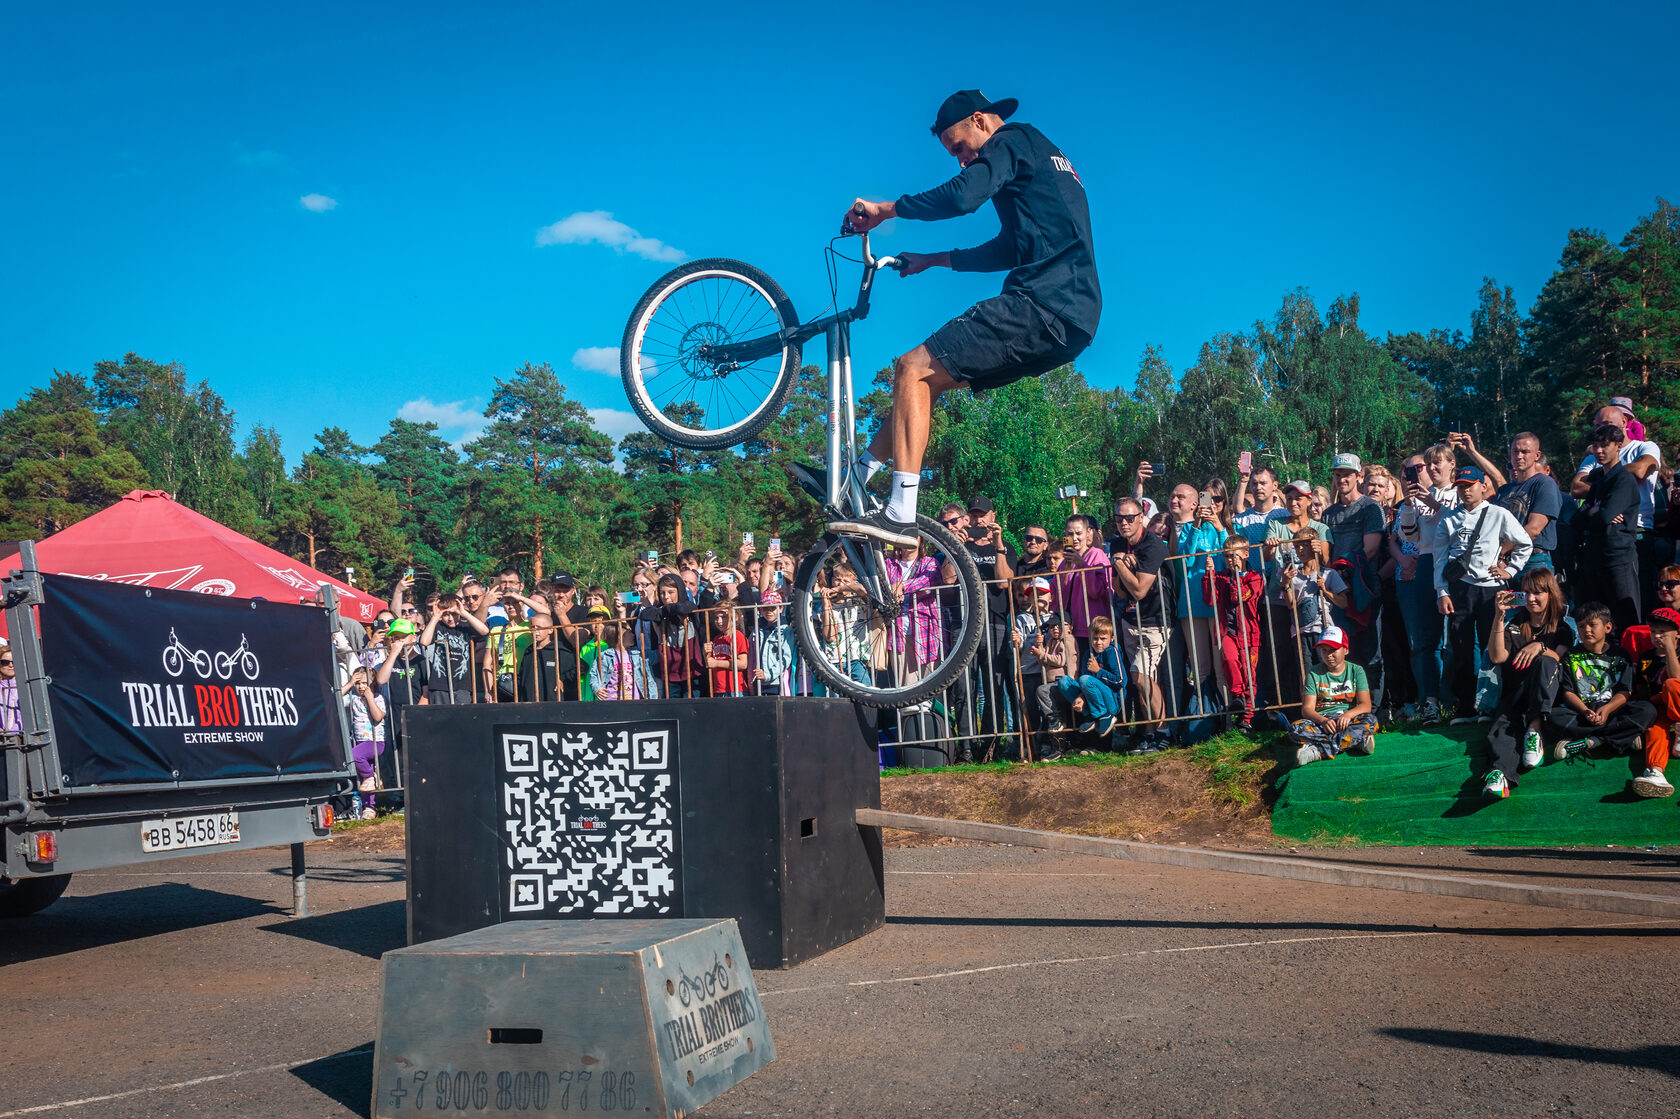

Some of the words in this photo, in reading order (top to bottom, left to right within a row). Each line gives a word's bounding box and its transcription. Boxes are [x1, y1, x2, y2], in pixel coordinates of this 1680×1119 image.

[634, 392, 656, 421] KENDA
[121, 681, 196, 727] TRIAL
[193, 684, 299, 727] BROTHERS
[183, 732, 234, 744] EXTREME
[235, 731, 264, 743] SHOW
[175, 818, 216, 844] 5458
[219, 815, 233, 833] 66
[219, 833, 230, 841] RUS
[663, 1010, 704, 1062] TRIAL
[698, 986, 756, 1045] BROTHERS
[698, 1043, 725, 1065] EXTREME
[724, 1036, 739, 1052] SHOW
[435, 1070, 489, 1111] 906
[495, 1070, 550, 1111] 800
[558, 1070, 592, 1111] 77
[600, 1070, 637, 1111] 86
